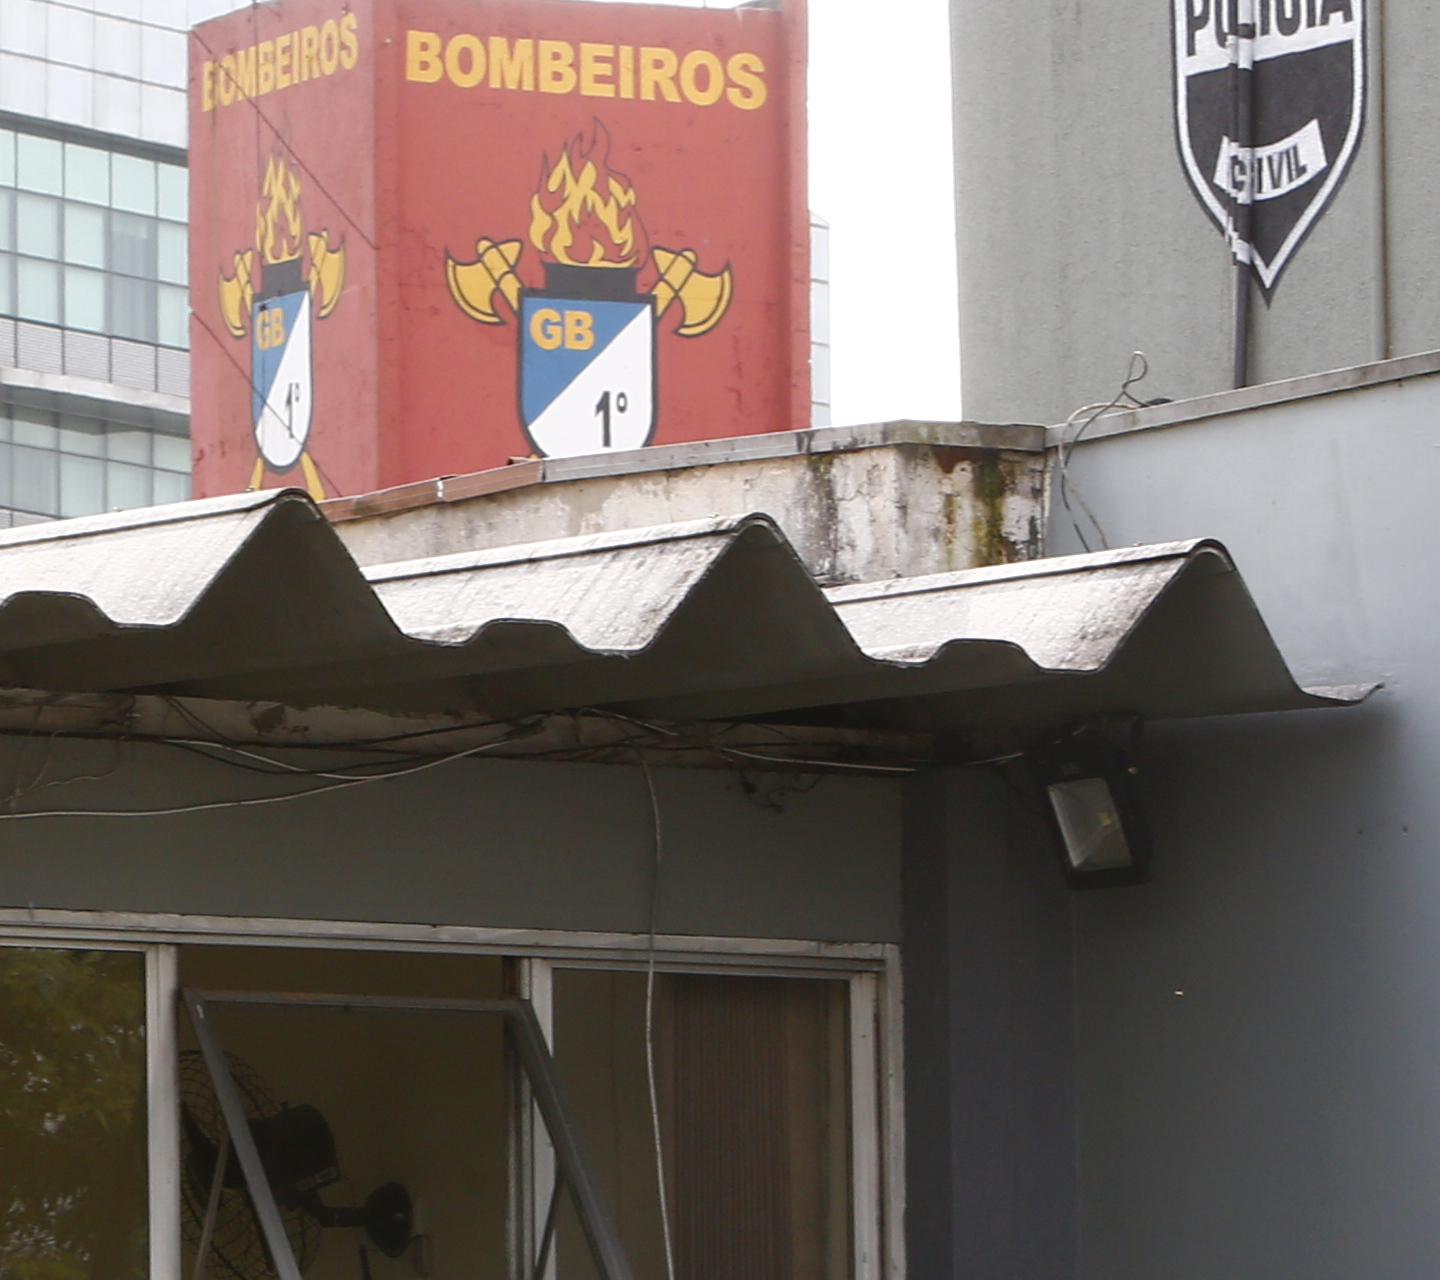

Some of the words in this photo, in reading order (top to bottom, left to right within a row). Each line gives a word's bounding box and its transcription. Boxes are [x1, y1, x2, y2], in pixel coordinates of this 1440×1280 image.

[406, 29, 767, 111] BOMBEIROS
[1231, 144, 1309, 194] CIVIL
[256, 307, 286, 350] GB
[530, 308, 596, 350] GB
